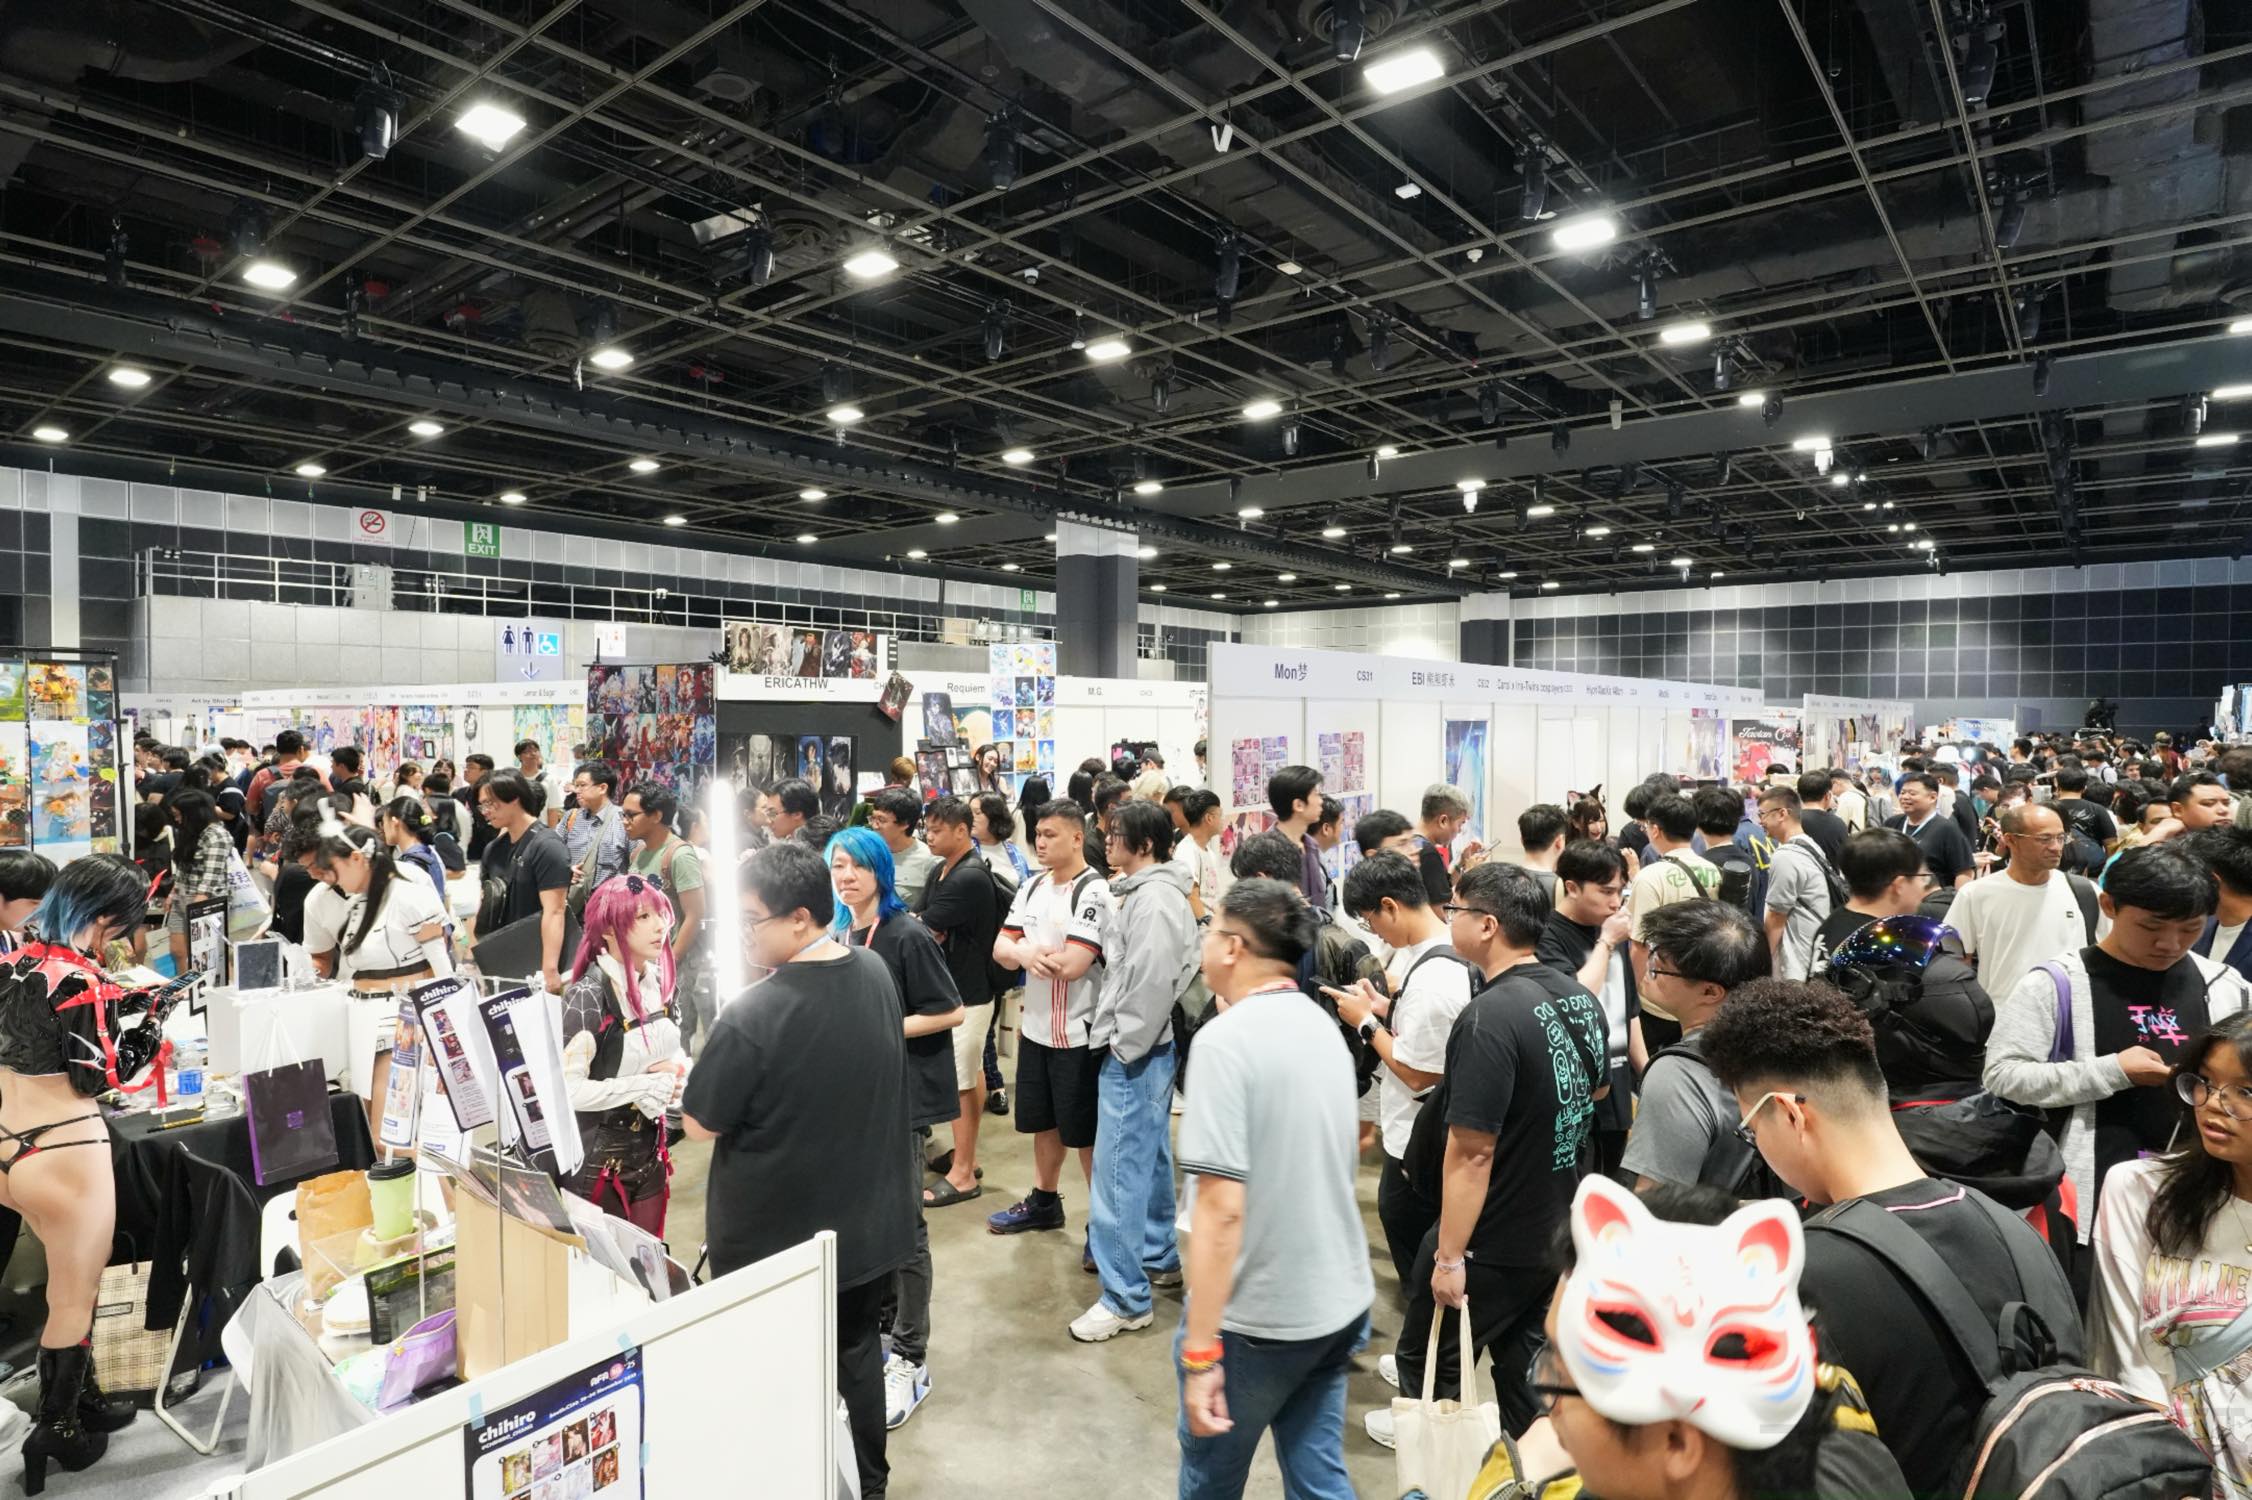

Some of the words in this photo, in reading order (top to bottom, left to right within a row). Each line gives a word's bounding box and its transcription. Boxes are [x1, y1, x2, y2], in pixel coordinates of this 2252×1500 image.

[468, 543, 497, 556] EXIT
[1357, 670, 1373, 681] CS31
[1412, 671, 1425, 686] EBI
[764, 677, 835, 693] ERICATHW_
[946, 682, 985, 694] Requiem
[1087, 686, 1104, 697] M.G.
[420, 985, 458, 1002] chihiro
[478, 1410, 537, 1444] chihiro
